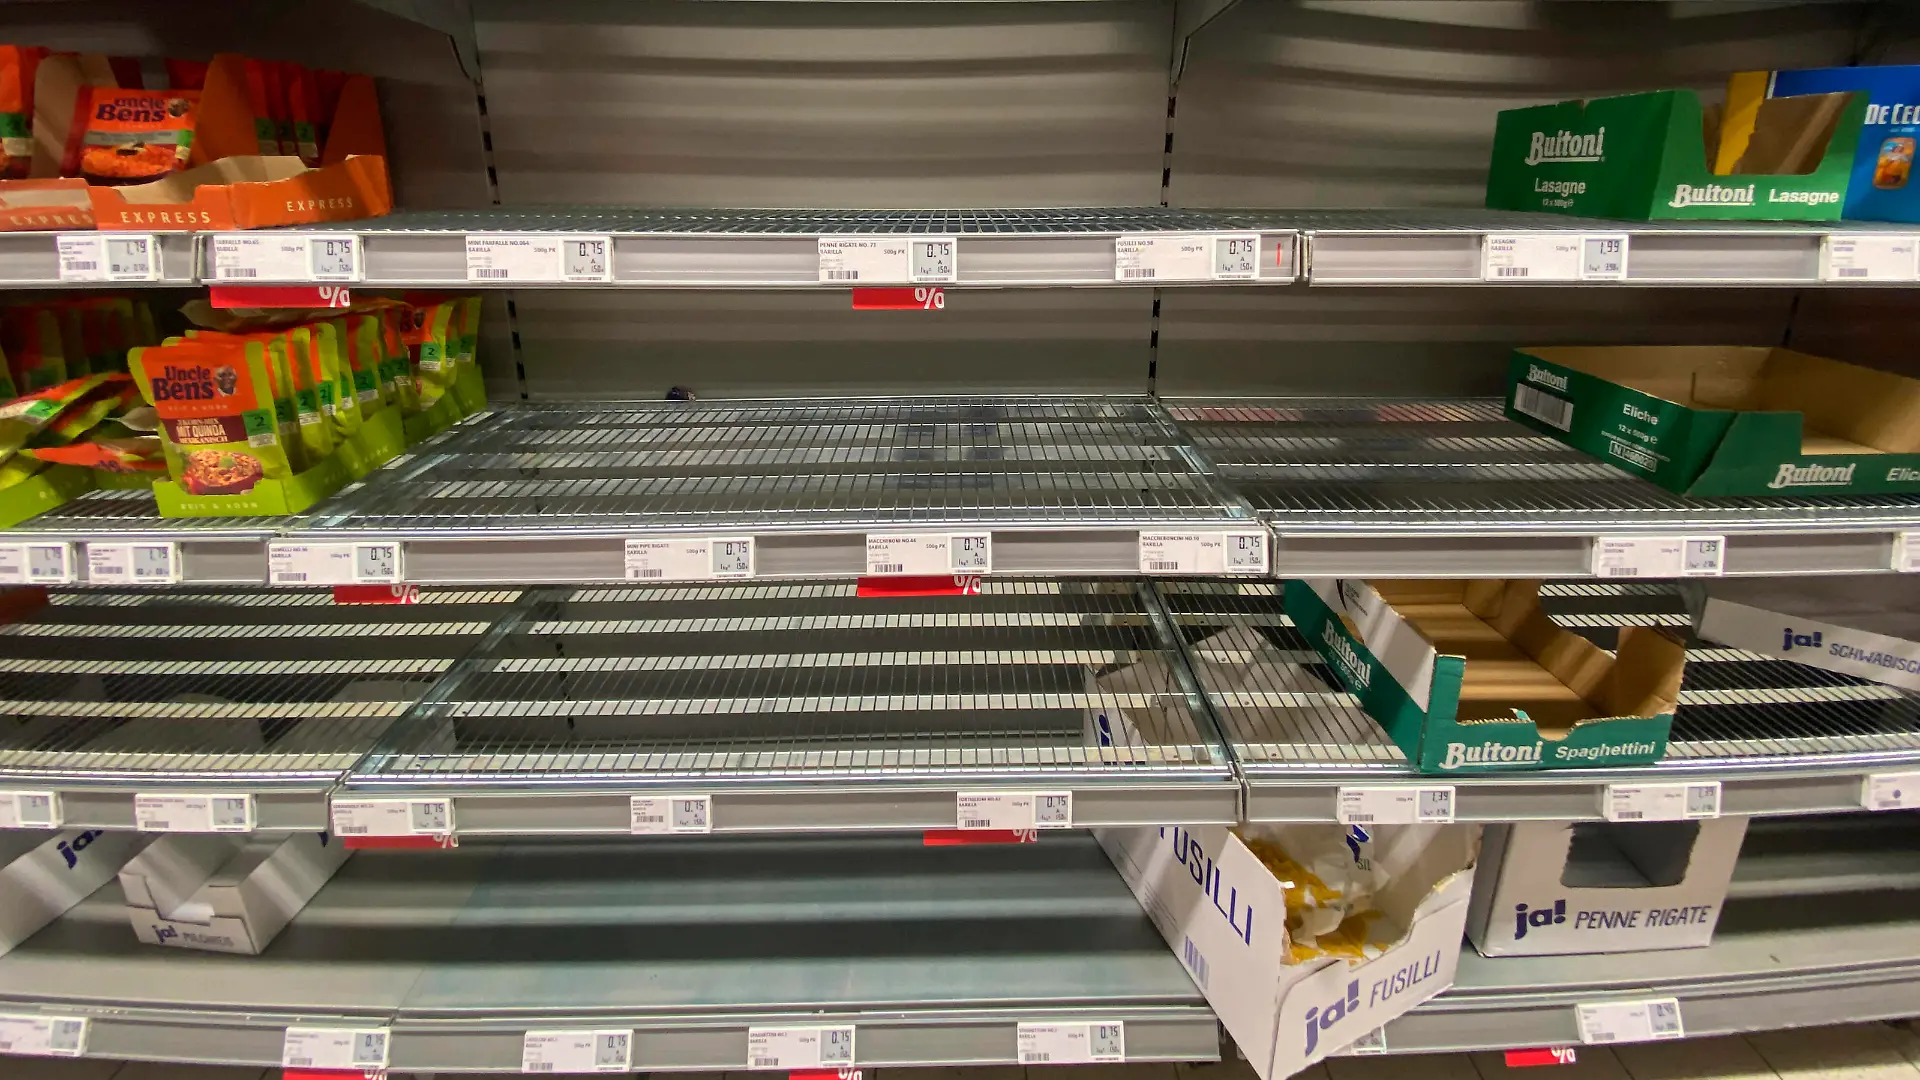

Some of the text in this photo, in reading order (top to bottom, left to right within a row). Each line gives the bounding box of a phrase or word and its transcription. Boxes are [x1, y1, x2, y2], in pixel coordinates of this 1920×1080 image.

[1864, 104, 1890, 125] DE
[1524, 126, 1606, 167] Buitoni
[1534, 178, 1587, 198] Lasagne
[1668, 183, 1835, 207] Buitoni Lasagne
[286, 197, 353, 213] EXPRESS
[120, 211, 212, 225] EXPRESS
[326, 242, 351, 257] 0.75
[579, 242, 603, 257] 0.75
[927, 243, 950, 258] 0.75
[1229, 240, 1253, 255] 0.75
[1599, 240, 1620, 255] 1.99
[427, 347, 435, 356] 2
[164, 365, 211, 381] Uncle
[1526, 364, 1569, 393] Buitoni
[256, 416, 266, 428] 2
[1622, 403, 1659, 426] Eliche
[176, 424, 227, 438] MIT QUINOA
[1767, 463, 1920, 489] Buitoni Elic
[726, 542, 748, 557] 0.75
[964, 538, 985, 552] 0.75
[1238, 536, 1260, 550] 0.75
[370, 547, 392, 561] 0.75
[1782, 627, 1823, 651] ja!
[1321, 618, 1372, 689] Buitoni
[1438, 741, 1656, 771] Buitoni Spaghettini
[424, 803, 444, 816] 0.75
[684, 800, 704, 813] 0.75
[1046, 796, 1066, 809] 0.75
[56, 830, 104, 870] ja
[1514, 899, 1713, 941] ja! PENNE RIGATE
[151, 924, 179, 945] ja!
[1303, 950, 1440, 1057] ja! FUSILLI
[831, 1030, 850, 1045] 0.75
[1099, 1026, 1118, 1039] 0.75
[608, 1035, 627, 1049] 0.75
